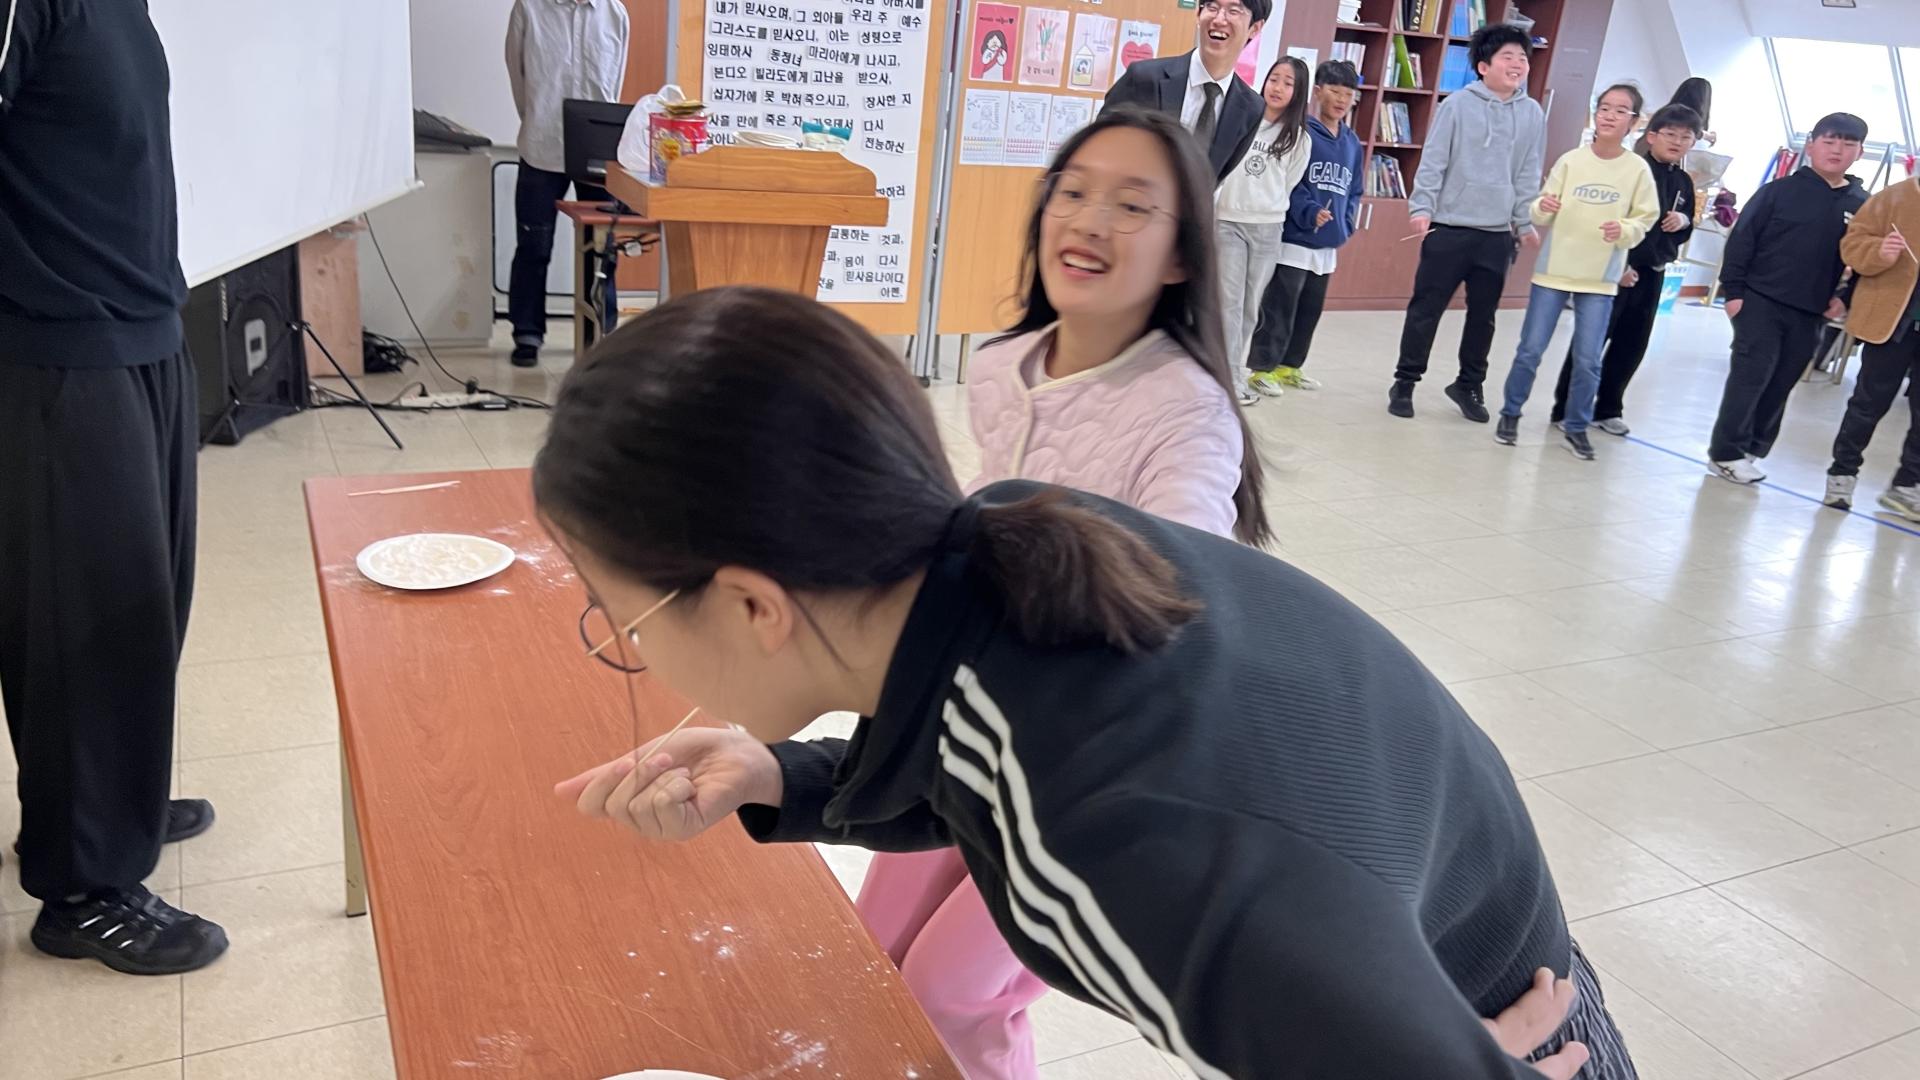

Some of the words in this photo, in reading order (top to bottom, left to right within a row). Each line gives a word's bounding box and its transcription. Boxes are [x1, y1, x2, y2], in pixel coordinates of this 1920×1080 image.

[716, 1, 738, 15] 내가
[796, 10, 806, 23] 그
[812, 11, 843, 24] 외아들
[850, 8, 872, 22] 우리
[878, 11, 888, 23] 주
[901, 15, 921, 28] 예수
[711, 21, 767, 40] 그리스도를
[829, 29, 849, 42] 이는
[861, 31, 902, 44] 성령으로
[707, 43, 752, 58] 잉태하사
[771, 48, 802, 67] 동정녀
[809, 45, 860, 66] 마리아에게
[714, 66, 747, 79] 본디오
[755, 67, 808, 83] 빌라도에게
[812, 70, 843, 84] 고난을
[713, 88, 757, 103] 십자가에
[764, 90, 775, 102] 못
[781, 92, 801, 106] 박혀
[866, 94, 896, 108] 장사한
[902, 93, 911, 105] 지
[737, 116, 758, 128] 만에
[765, 113, 786, 127] 죽은
[864, 119, 884, 132] 다시
[865, 137, 905, 154] 전능하신
[1572, 186, 1620, 201] move
[845, 255, 864, 268] 몸이
[879, 254, 898, 266] 다시
